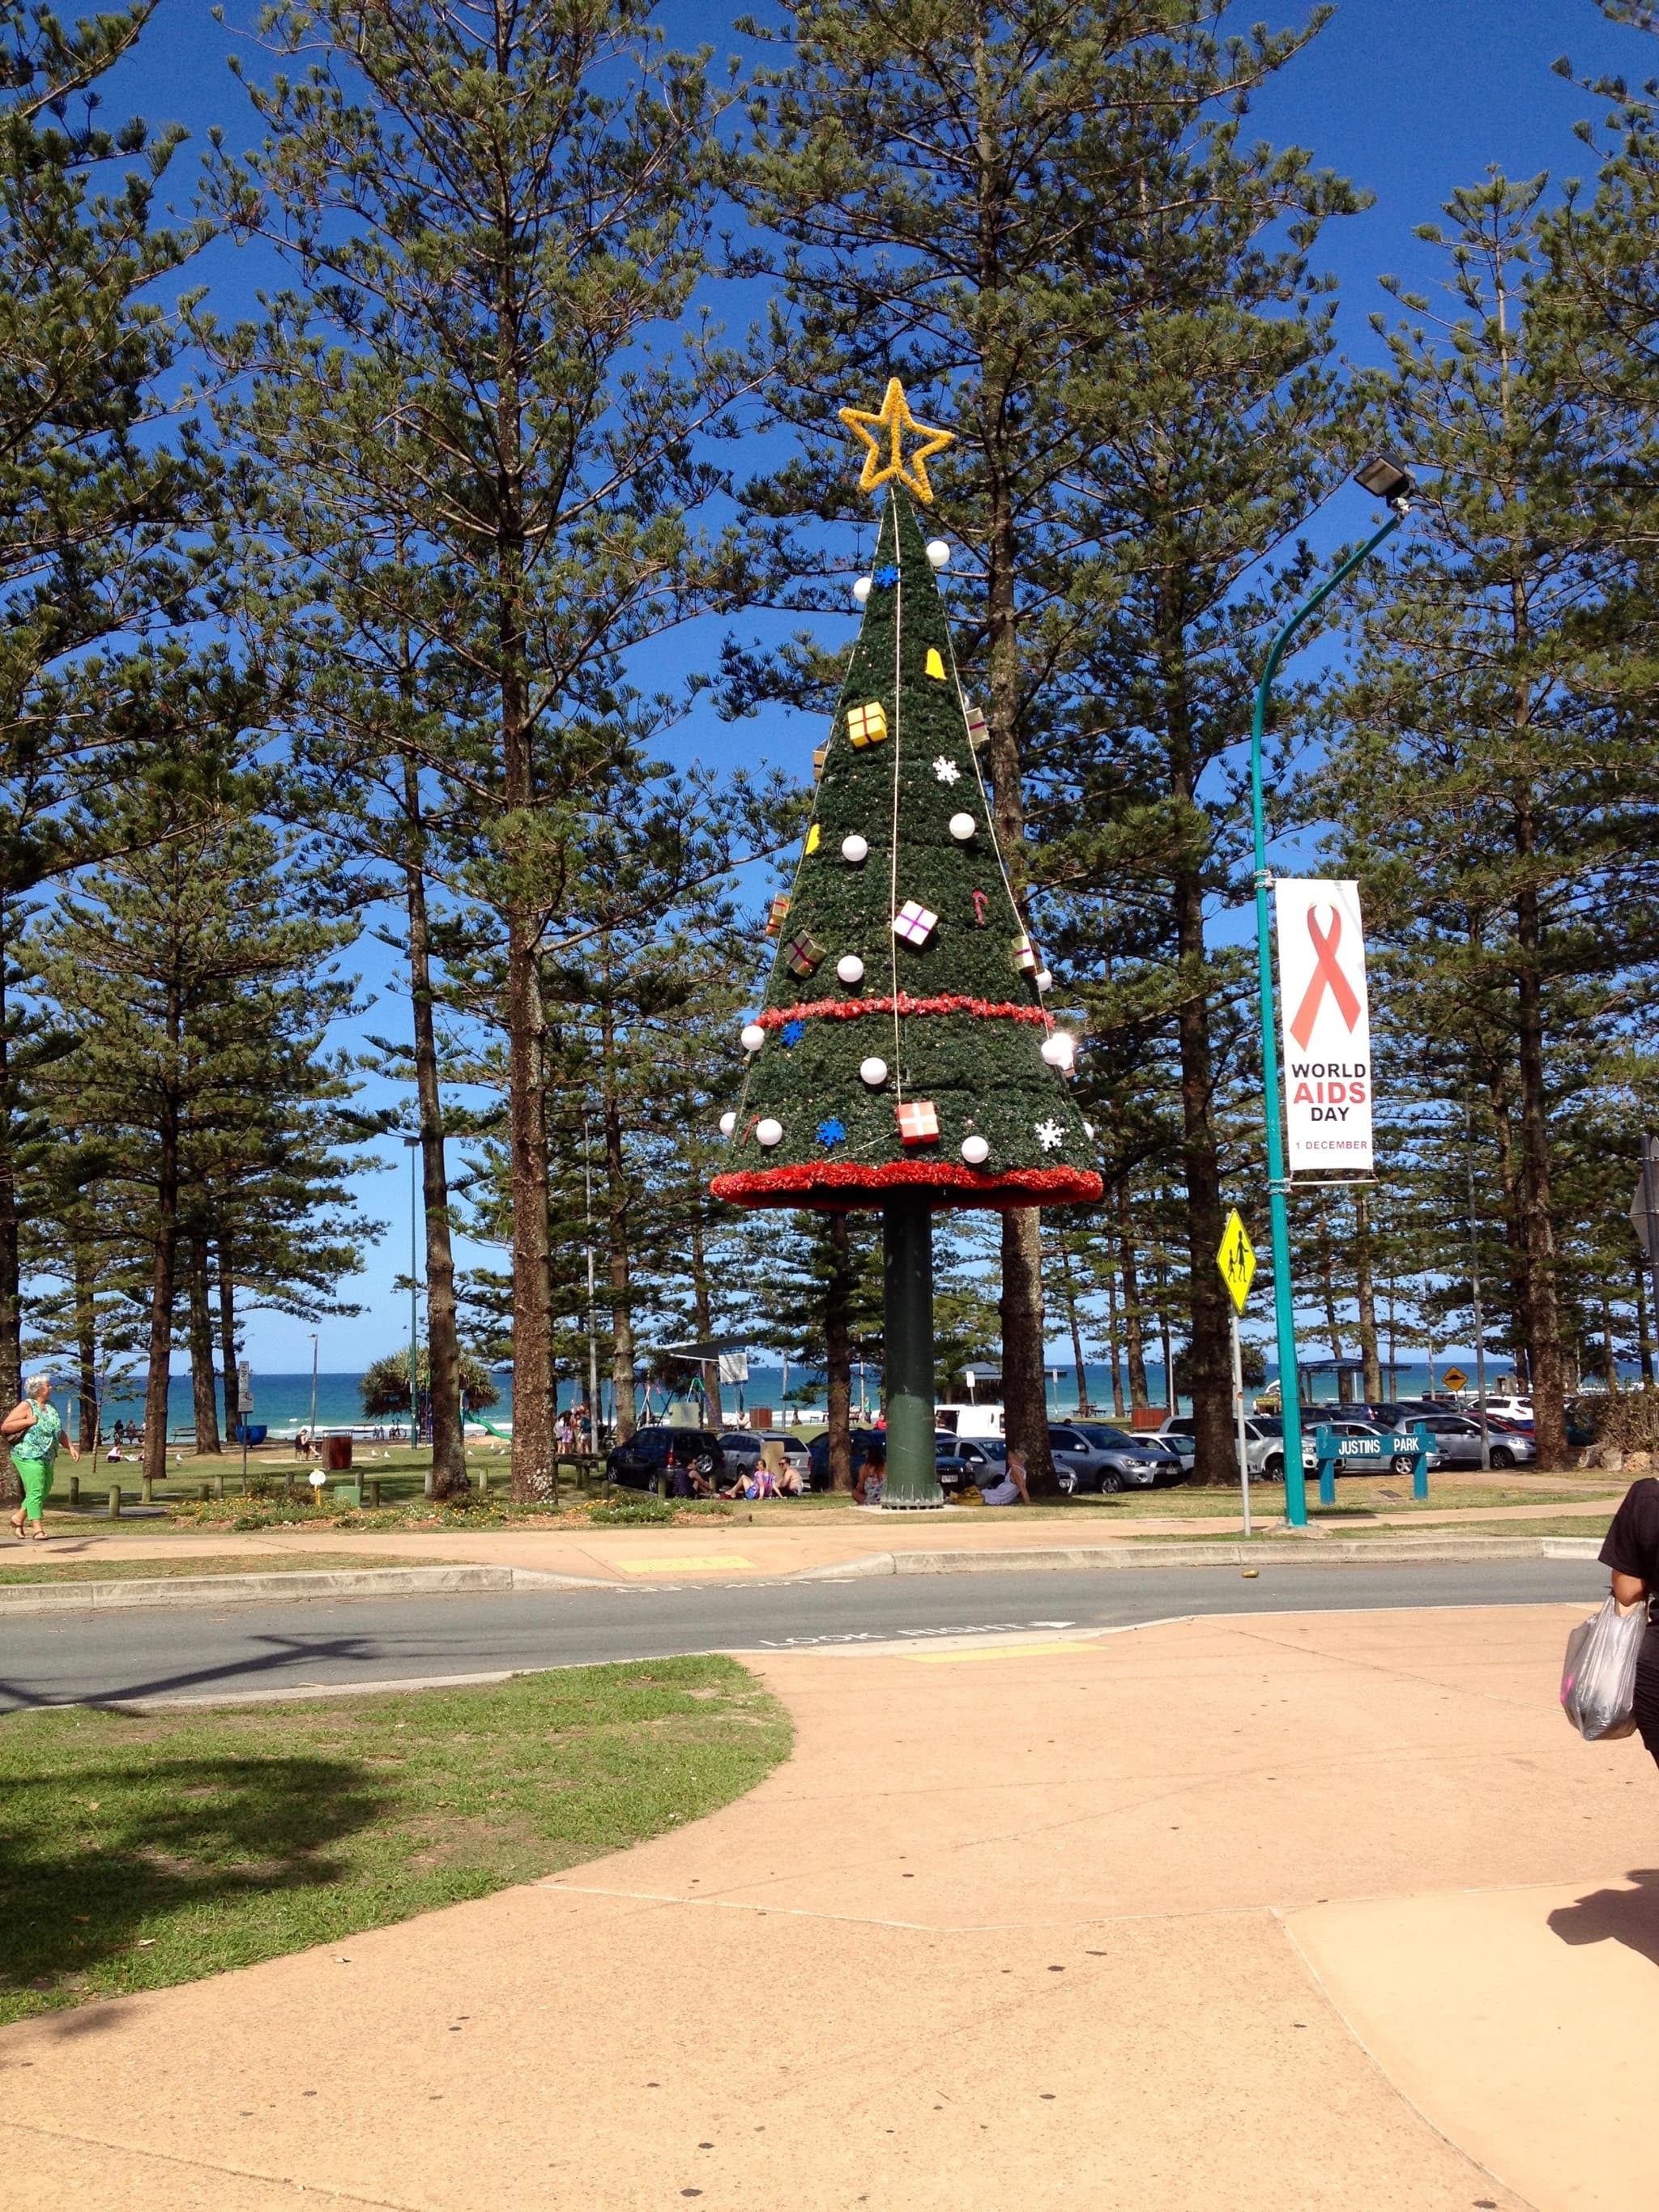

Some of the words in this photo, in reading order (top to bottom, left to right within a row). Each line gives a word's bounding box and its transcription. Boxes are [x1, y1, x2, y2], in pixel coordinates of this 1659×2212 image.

[1291, 1063, 1367, 1078] WORLD
[1293, 1081, 1367, 1104] AIDS
[1311, 1107, 1350, 1122] DAY
[1305, 1140, 1367, 1149] DECEMBER
[1338, 1438, 1380, 1455] JUSTINS
[1393, 1437, 1420, 1452] PARK
[758, 1632, 887, 1647] LOOK
[896, 1624, 1026, 1636] RIGHT
